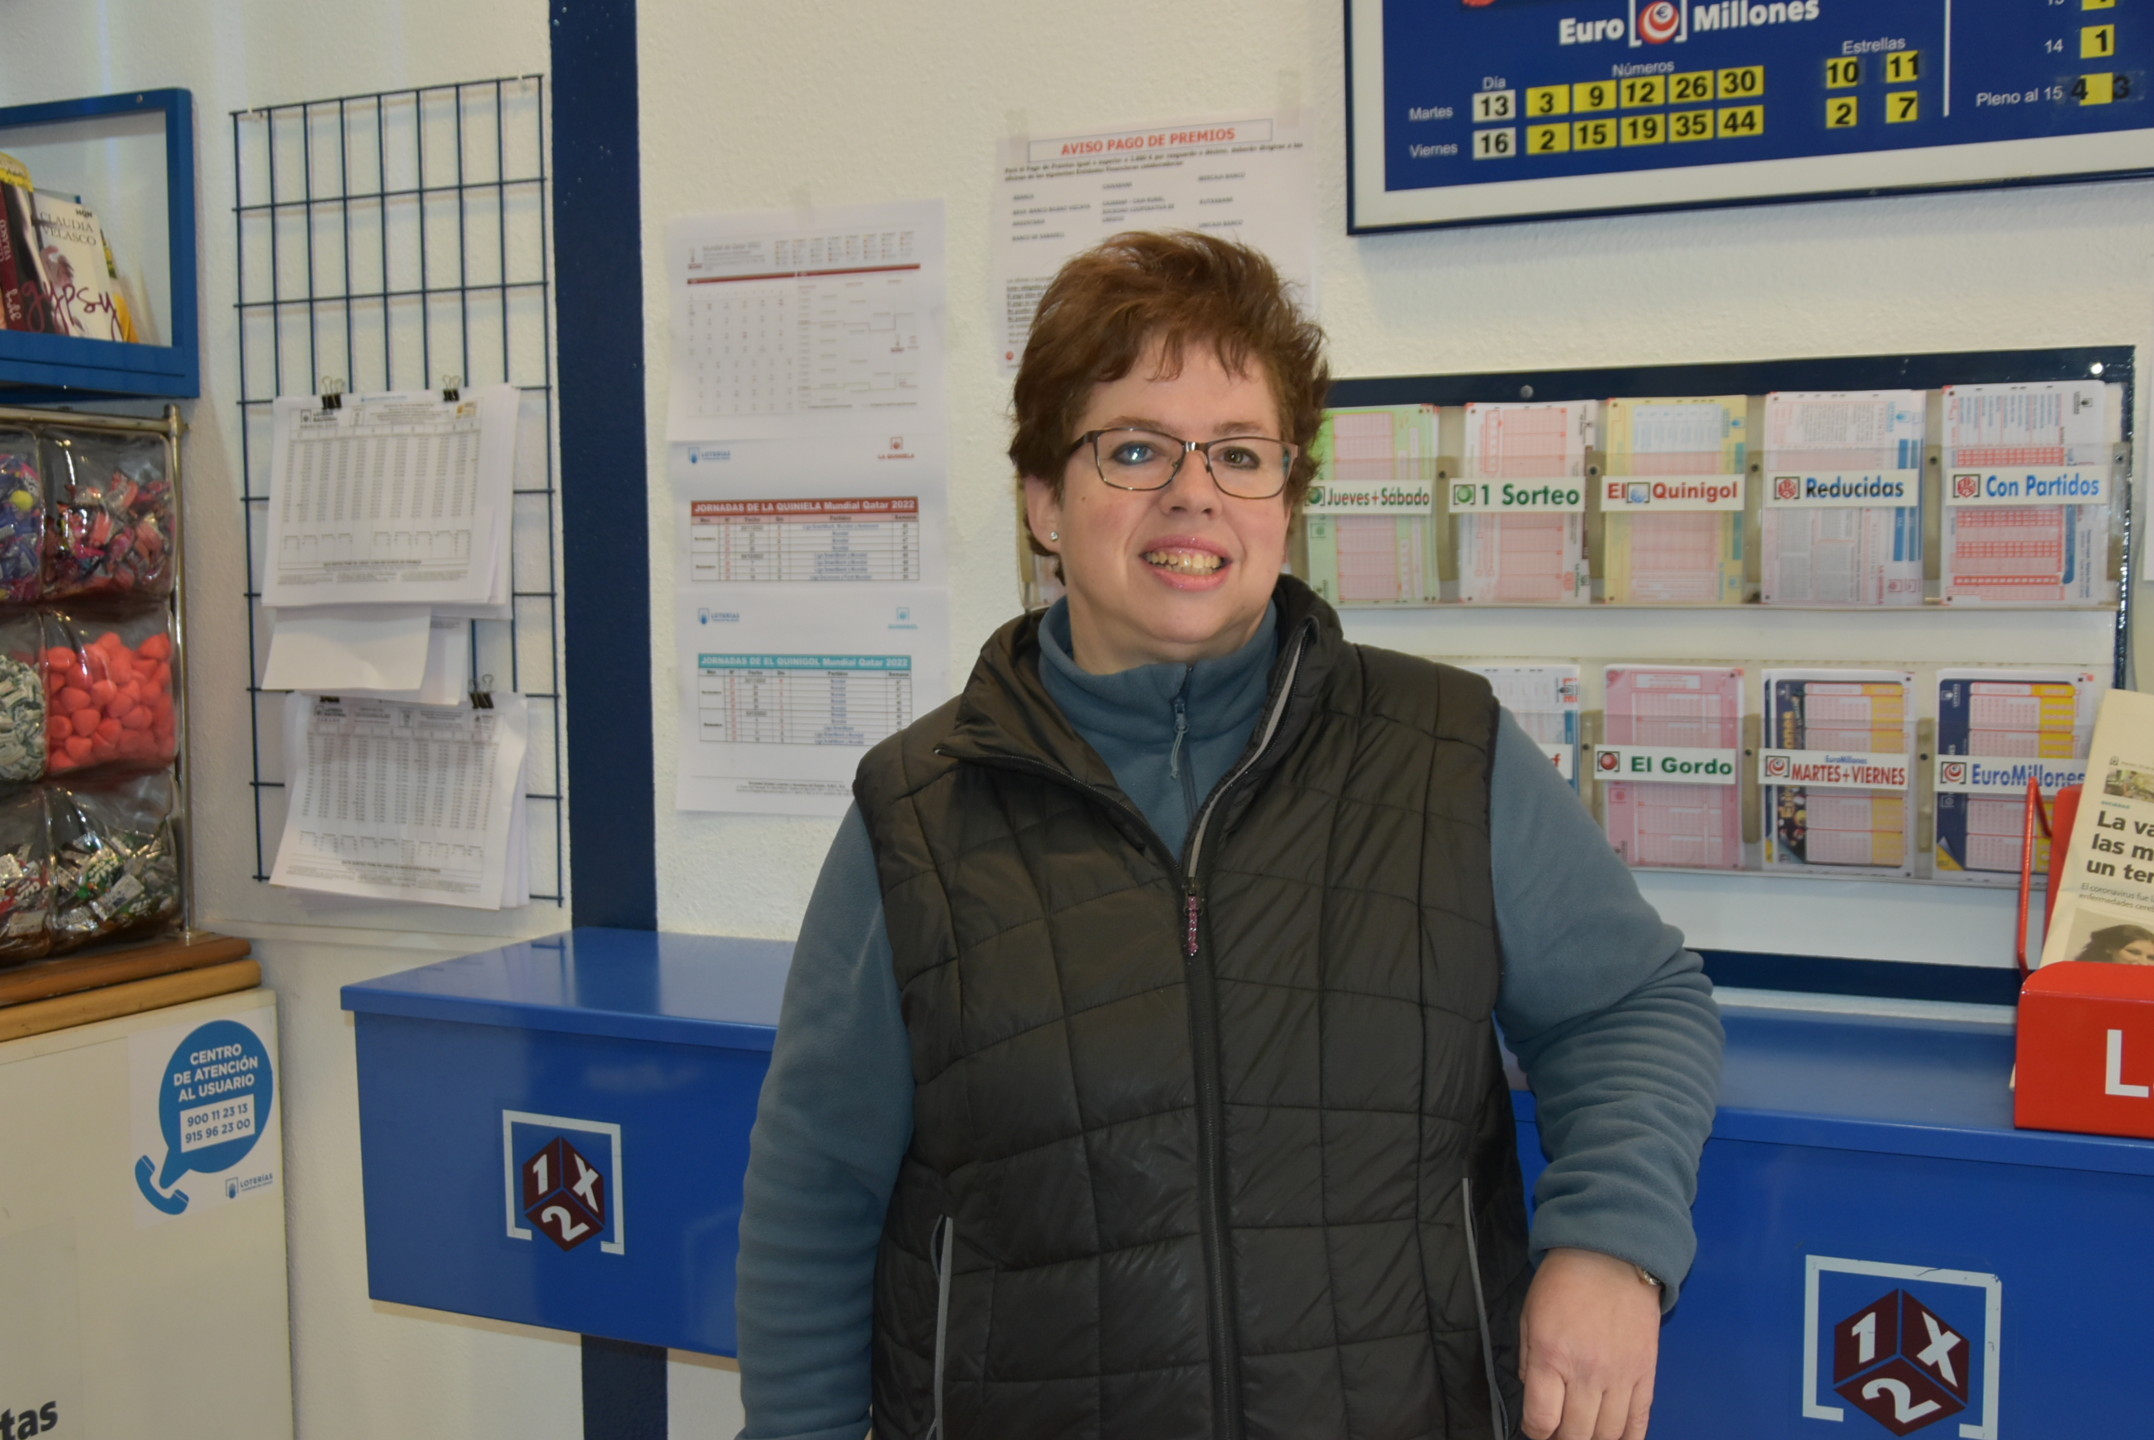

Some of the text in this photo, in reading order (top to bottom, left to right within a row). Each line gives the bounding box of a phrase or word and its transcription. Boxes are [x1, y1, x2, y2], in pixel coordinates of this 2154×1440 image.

[1559, 0, 1819, 45] Euro Millones
[1842, 38, 1905, 55] Estrellas
[2045, 29, 2107, 53] 14 1
[1613, 61, 1674, 78] Números
[1409, 55, 1919, 121] Martes 13 3 9 12 26 30 10 11
[1483, 76, 1506, 91] Día
[1976, 75, 2130, 108] Pleno al 15 4 3
[1410, 97, 1915, 158] Viernes 16 2 15 19 35 44 2 7
[1061, 128, 1236, 155] AVISO PAGO DE PREMIOS
[40, 211, 93, 232] CLAUDIA
[43, 226, 96, 246] VELASCO
[1481, 484, 1580, 506] 1 Sorteo
[1608, 482, 1738, 503] El Quinigol
[1806, 476, 1904, 498] Reducidas
[1986, 473, 2100, 497] Con Partidos
[695, 500, 914, 512] JORNADAS DE LA QUINIELA Mundial Qatar 2022
[701, 656, 747, 664] JORNADAS
[749, 657, 761, 665] DE
[764, 657, 774, 665] EL
[823, 658, 856, 666] Mundial
[859, 659, 883, 667] Qatar
[886, 659, 908, 667] 2022
[1631, 756, 1733, 776] El Gordo
[1825, 754, 1867, 766] EuroMillones
[1792, 763, 1905, 787] MARTES+VIERNES
[1972, 764, 2085, 788] EuroMillones
[2097, 810, 2126, 831] La
[2091, 833, 2125, 855] las
[2086, 859, 2116, 877] un
[2078, 892, 2133, 909] enfermedades
[2089, 885, 2134, 899] coronavirus
[190, 1043, 242, 1065] CENTRO
[174, 1055, 259, 1086] DE ATENCIÓN
[179, 1073, 255, 1103] AL USUARIO
[187, 1103, 248, 1127] 900 11 23 13
[185, 1118, 251, 1144] 915 96 23 00
[533, 1152, 599, 1242] 1 X 2
[1852, 1311, 1961, 1424] 1 X 2
